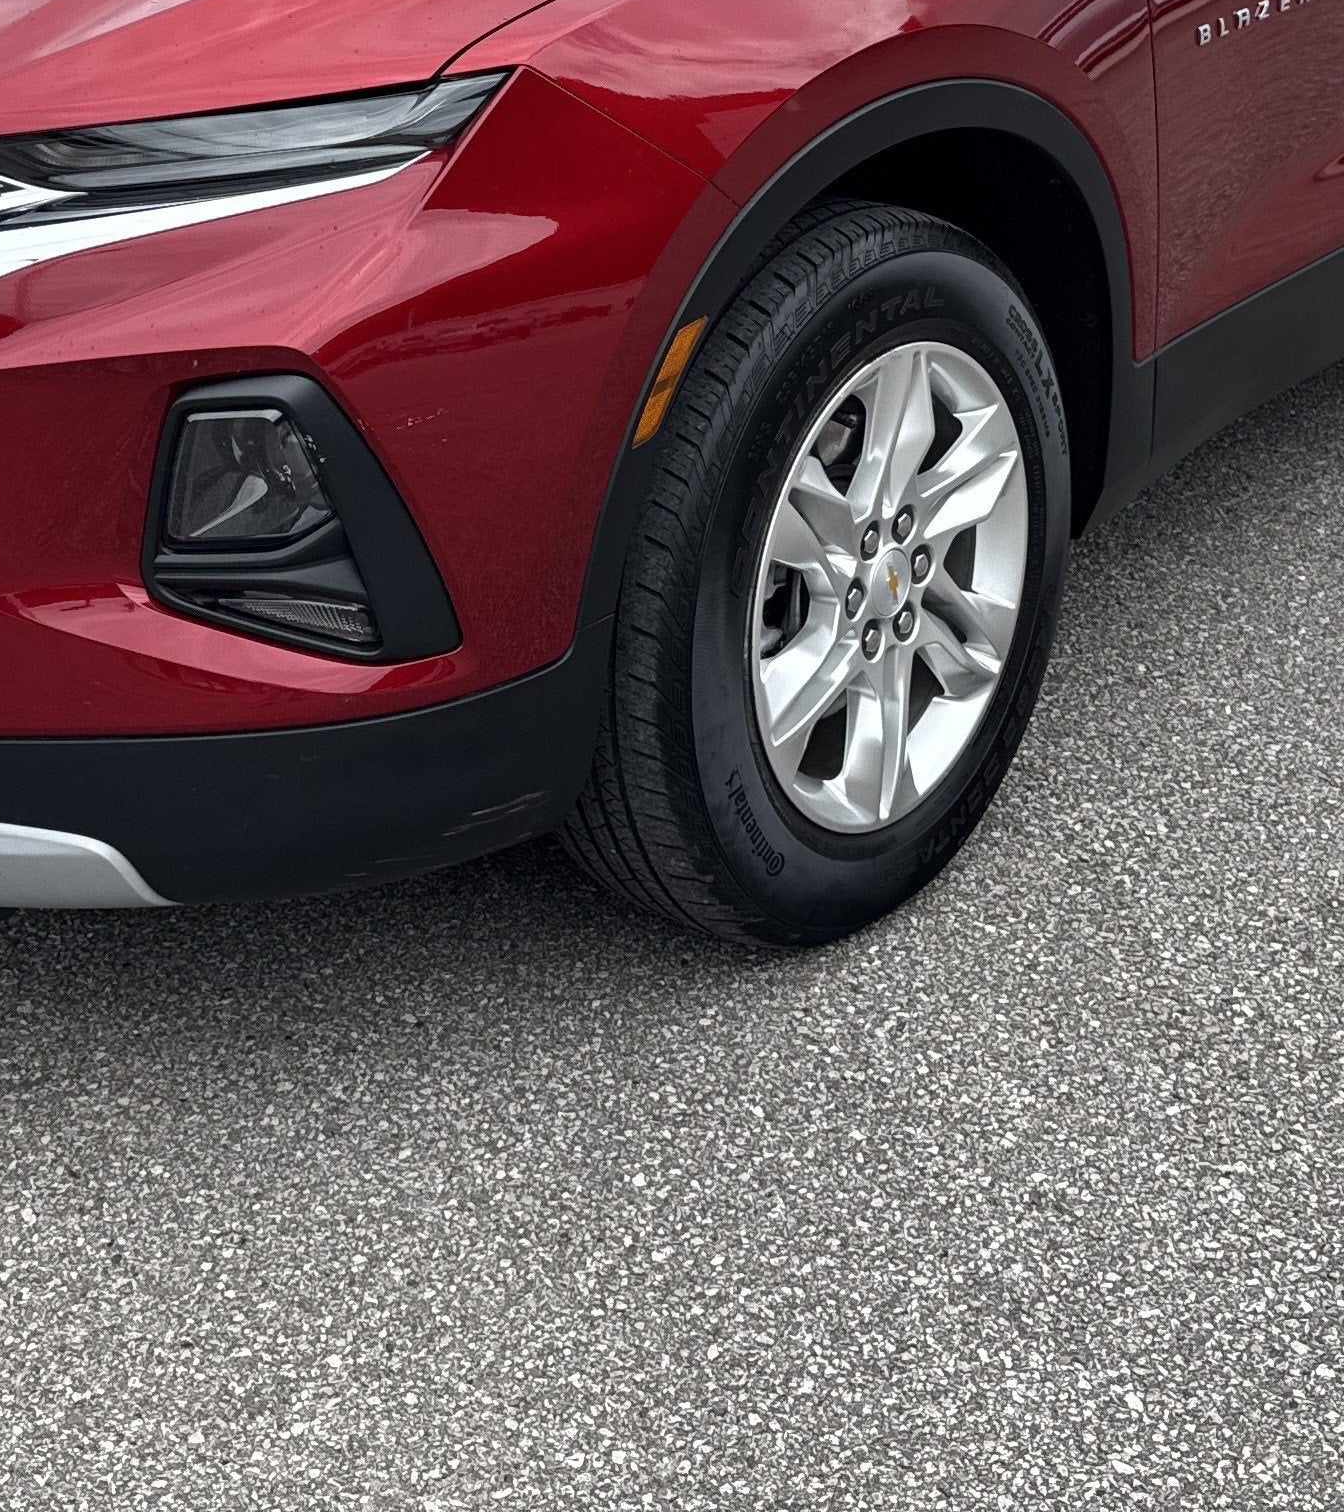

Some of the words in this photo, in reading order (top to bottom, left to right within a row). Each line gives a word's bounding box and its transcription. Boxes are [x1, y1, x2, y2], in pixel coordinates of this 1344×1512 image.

[582, 276, 629, 298] TOYOTA
[1034, 348, 1056, 399] LX
[730, 285, 945, 597] CONTINENTAL
[727, 782, 786, 877] Continental
